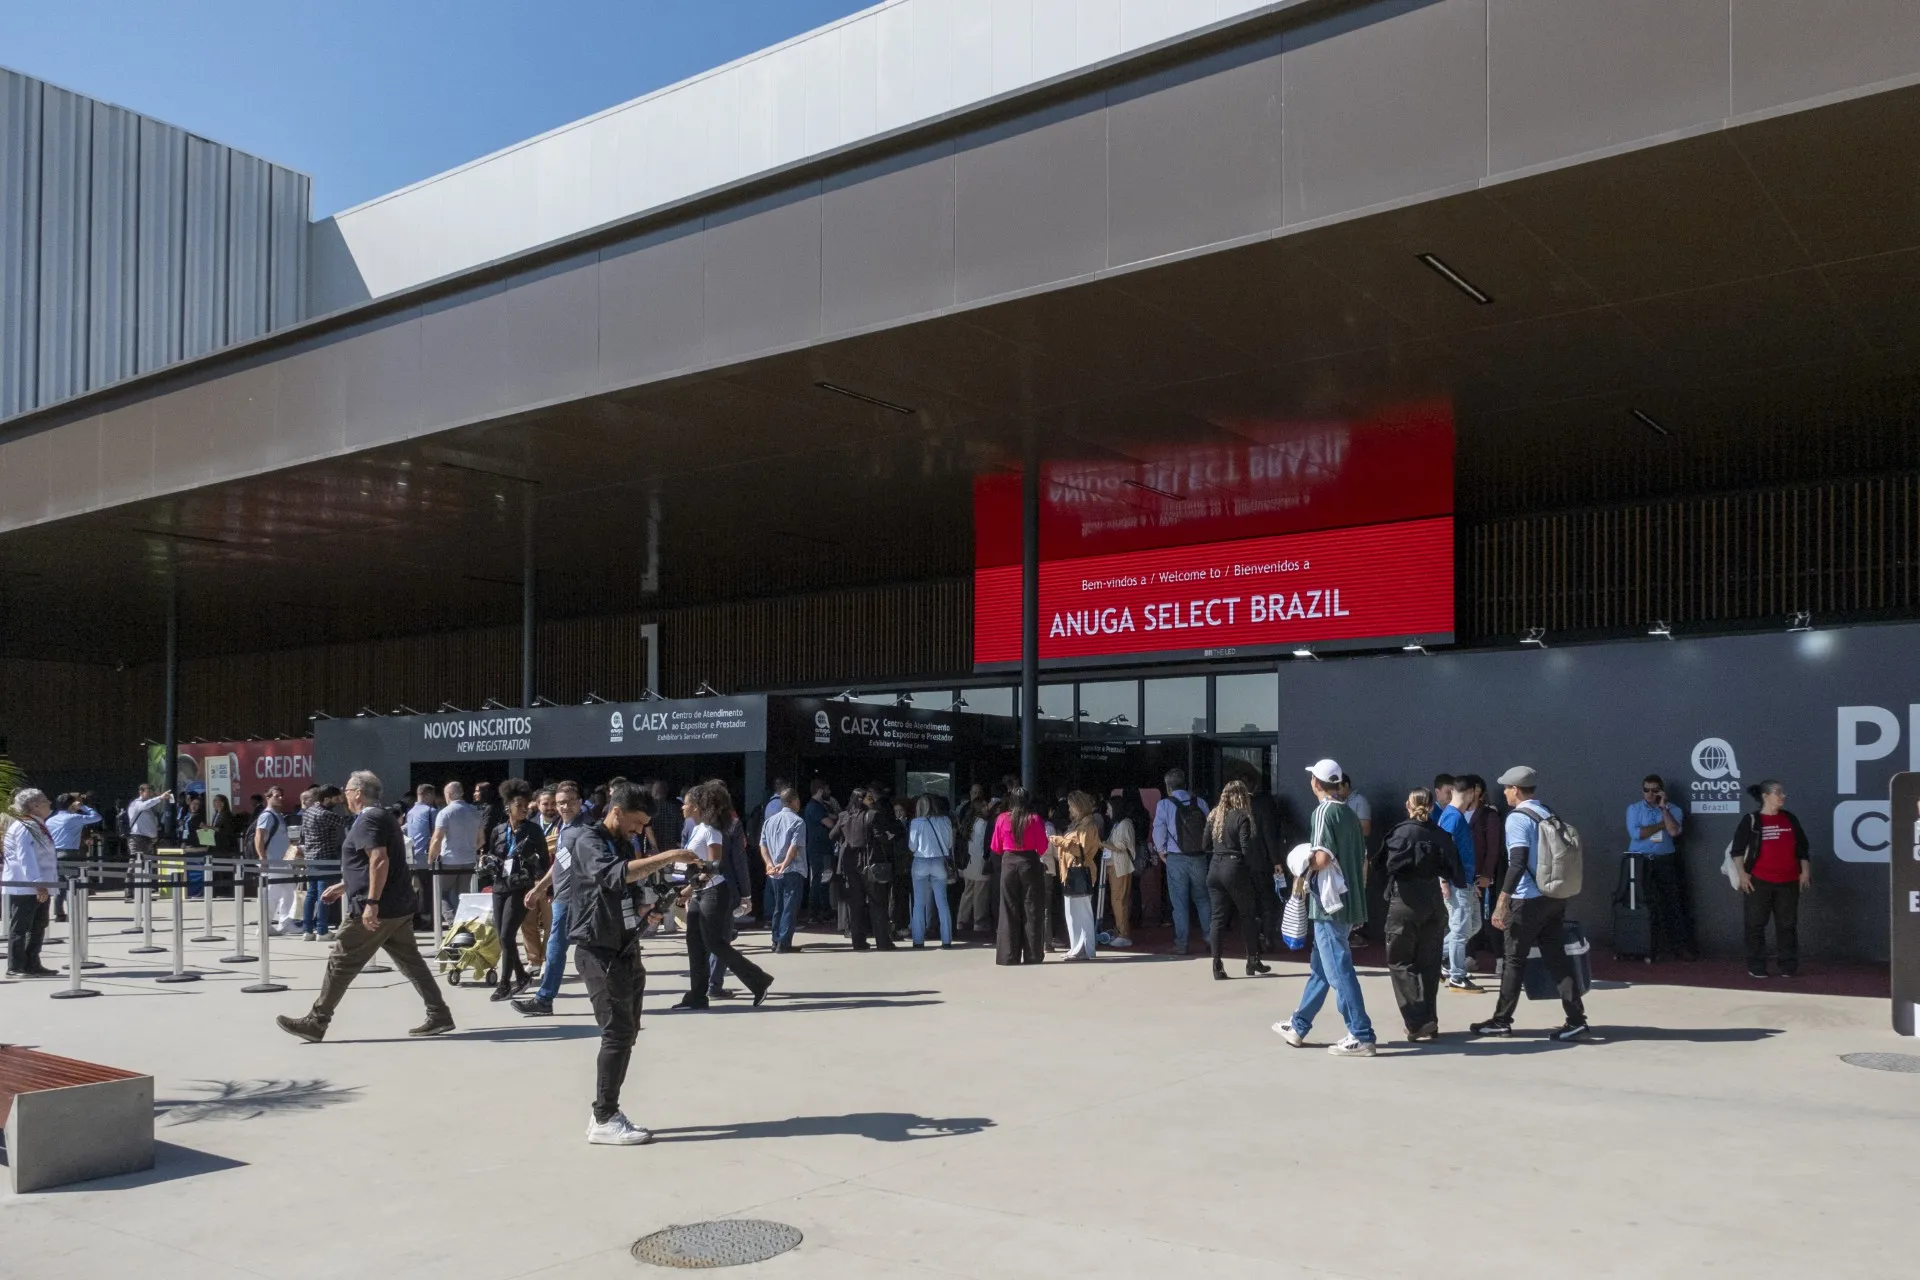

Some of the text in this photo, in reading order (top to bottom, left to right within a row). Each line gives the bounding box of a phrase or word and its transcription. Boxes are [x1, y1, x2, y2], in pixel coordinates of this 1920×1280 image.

[1081, 560, 1310, 591] Bem-vindos a / Welcome to / Bienvenidos a
[1049, 588, 1350, 638] ANUGA SELECT BRAZIL
[671, 708, 744, 720] Centro de Atendimento
[424, 716, 532, 740] NOVOS INSCRITOS
[632, 712, 668, 731] CAEX
[680, 721, 709, 731] Expositor
[715, 719, 747, 729] Prestador
[840, 716, 880, 736] CAEX
[883, 718, 951, 731] Centro de Atendimento
[701, 732, 719, 740] Center
[892, 729, 921, 740] Expositor
[926, 733, 954, 742] Prestador
[457, 738, 531, 753] NEW REGISTRATION
[869, 739, 896, 748] Exhibitor's
[896, 741, 913, 749] Service
[255, 755, 314, 779] CREDEN
[1690, 780, 1741, 794] anuga
[1691, 792, 1741, 800] SELECT
[1702, 803, 1728, 811] Brazil
